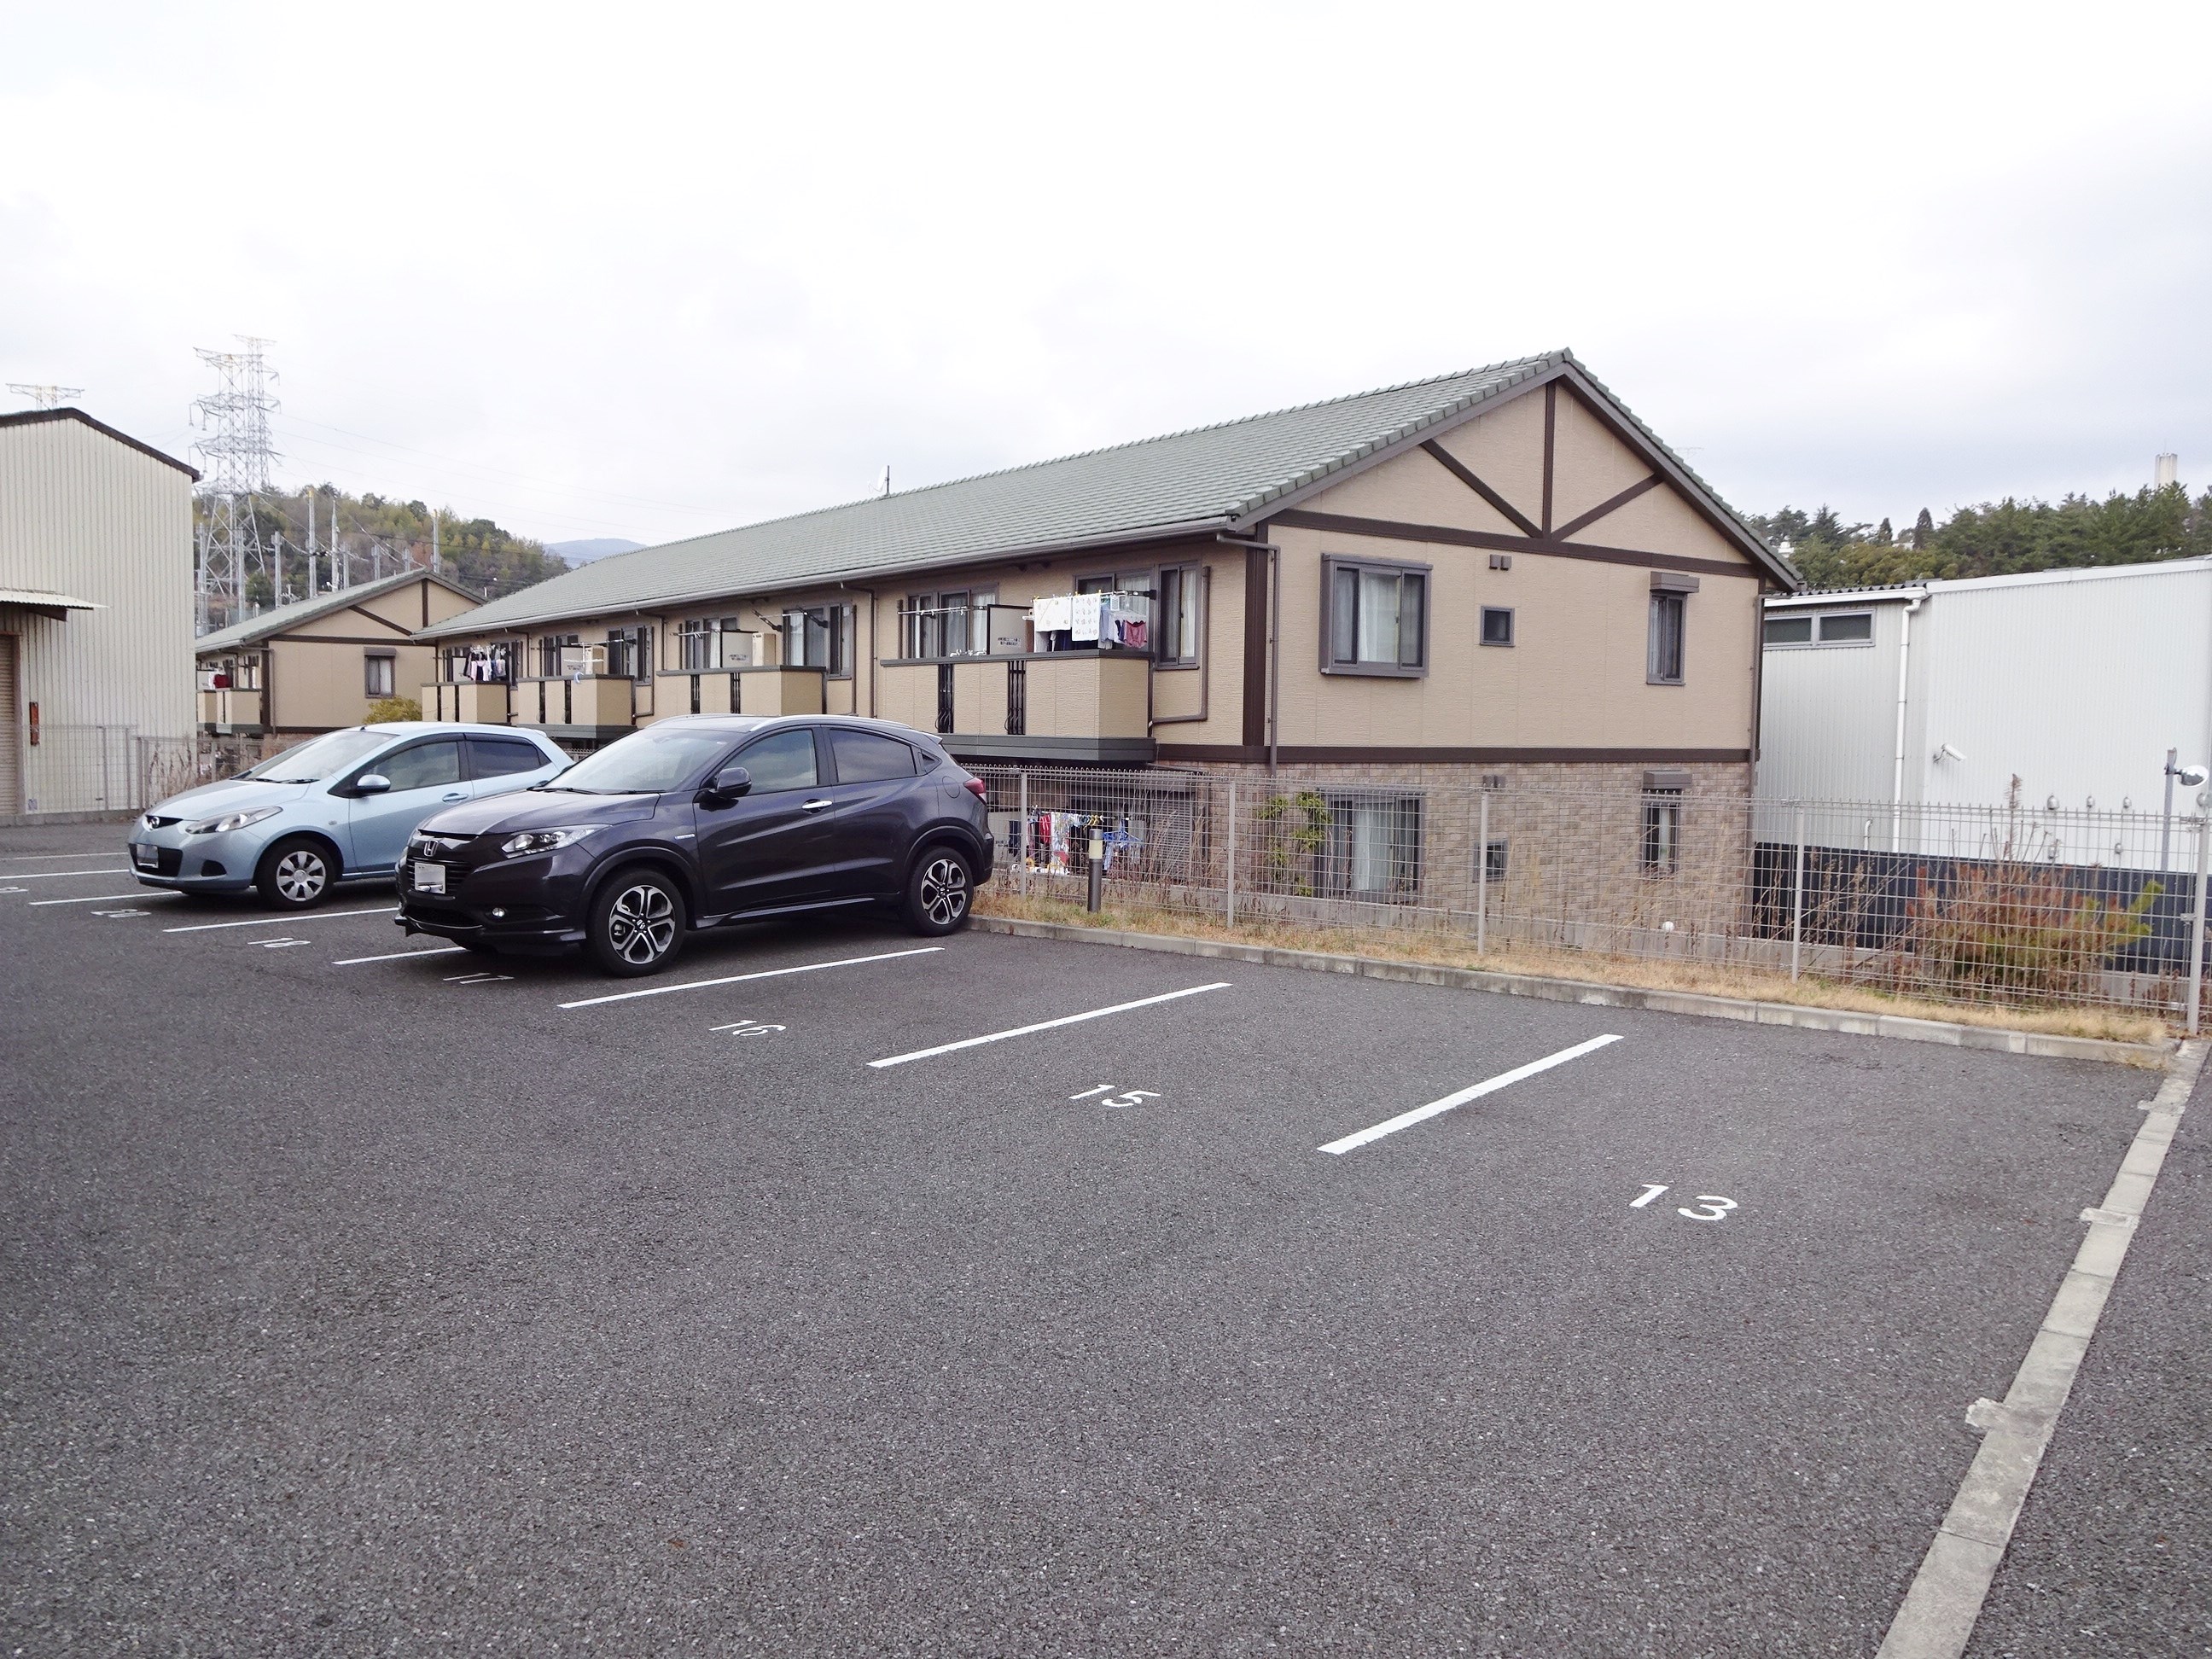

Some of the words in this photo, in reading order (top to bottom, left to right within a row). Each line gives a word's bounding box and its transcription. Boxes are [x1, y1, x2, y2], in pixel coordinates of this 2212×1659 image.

[247, 937, 311, 947] 18
[443, 972, 515, 984] 17
[709, 1020, 786, 1036] 16
[1068, 1084, 1161, 1107] 15
[1629, 1184, 1738, 1221] 13
